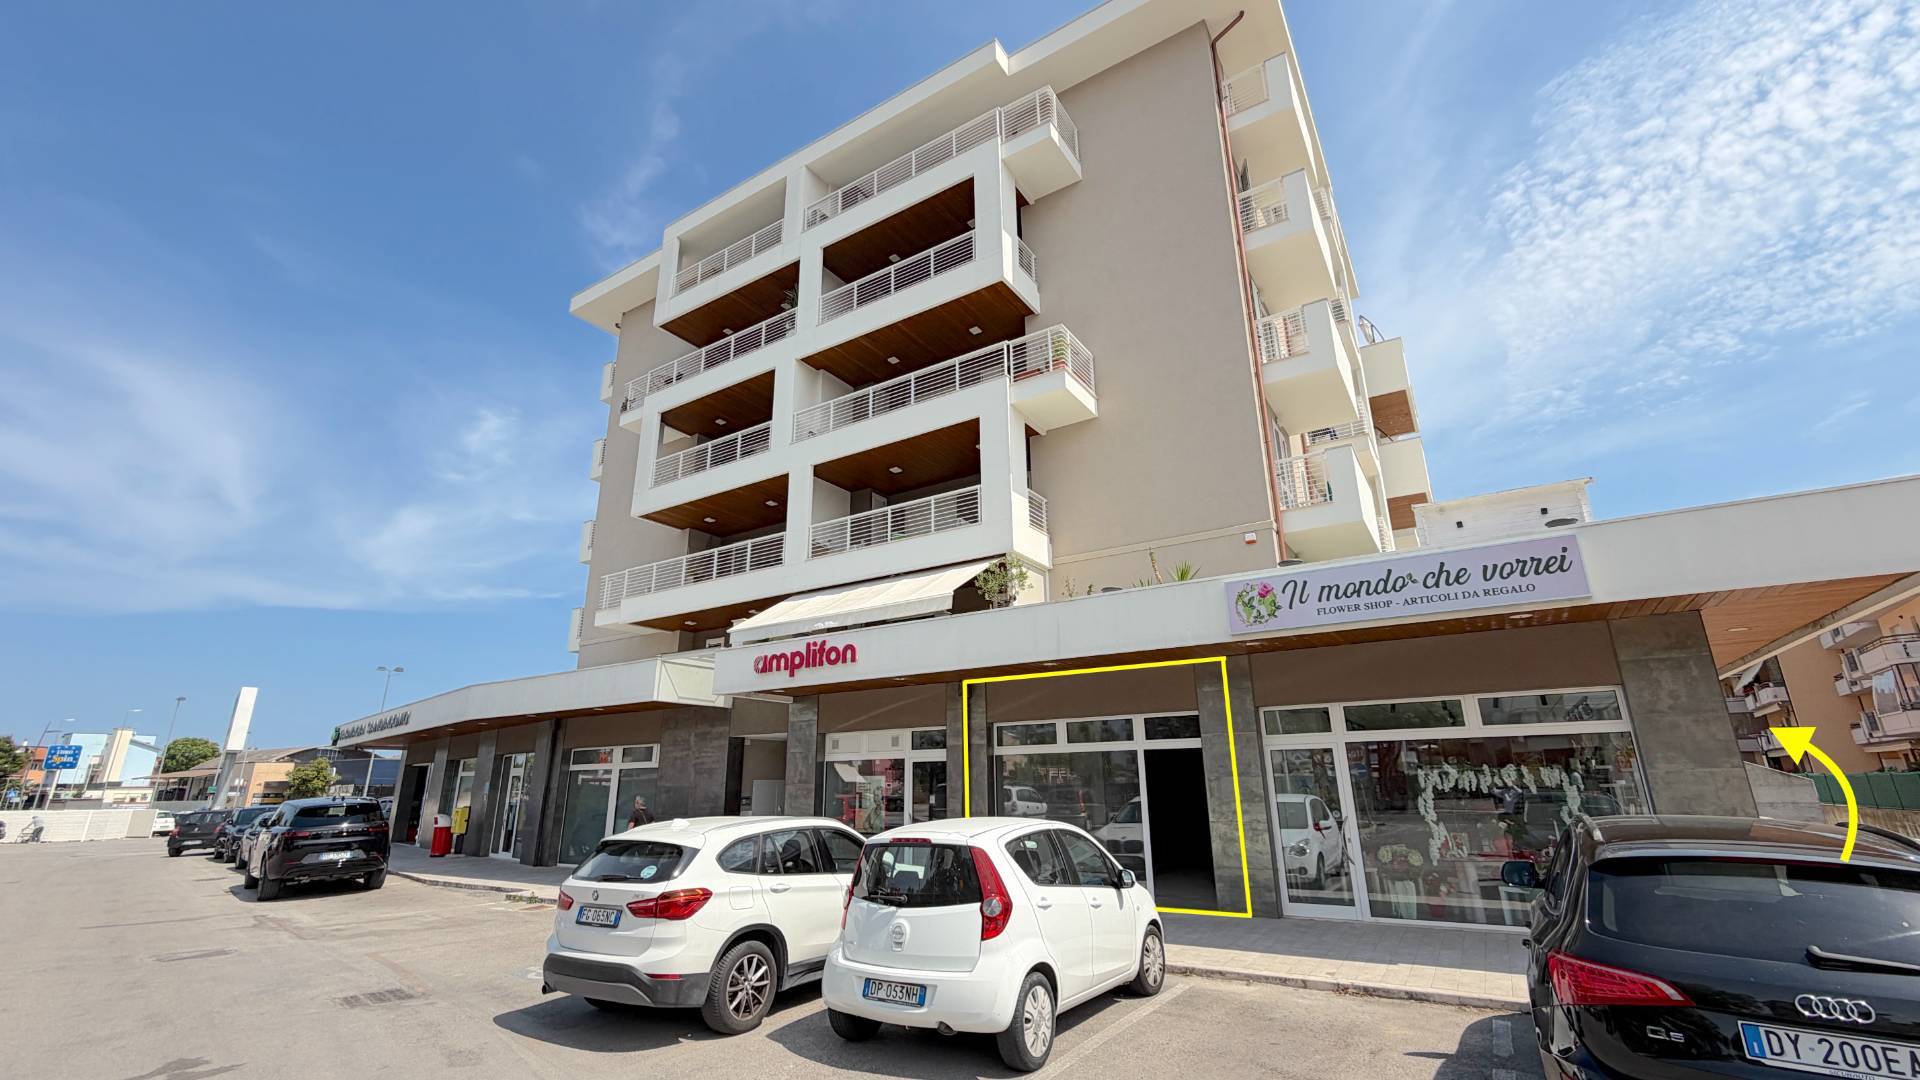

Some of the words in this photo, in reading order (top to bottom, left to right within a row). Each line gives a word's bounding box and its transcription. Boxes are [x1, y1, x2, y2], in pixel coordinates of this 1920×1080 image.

[1282, 579, 1309, 610] Il
[1318, 569, 1409, 603] mondo
[1422, 562, 1471, 589] che
[1482, 546, 1573, 582] vorrei
[1316, 602, 1362, 616] FLOWER
[1364, 600, 1393, 611] SHOP
[1402, 592, 1459, 607] ARTICOLI
[1461, 589, 1480, 600] DA
[1483, 583, 1536, 597] REGALO
[754, 639, 857, 678] amplifon
[870, 981, 883, 996] DP
[886, 983, 919, 1003] 053NH
[1764, 1029, 1801, 1060] DY
